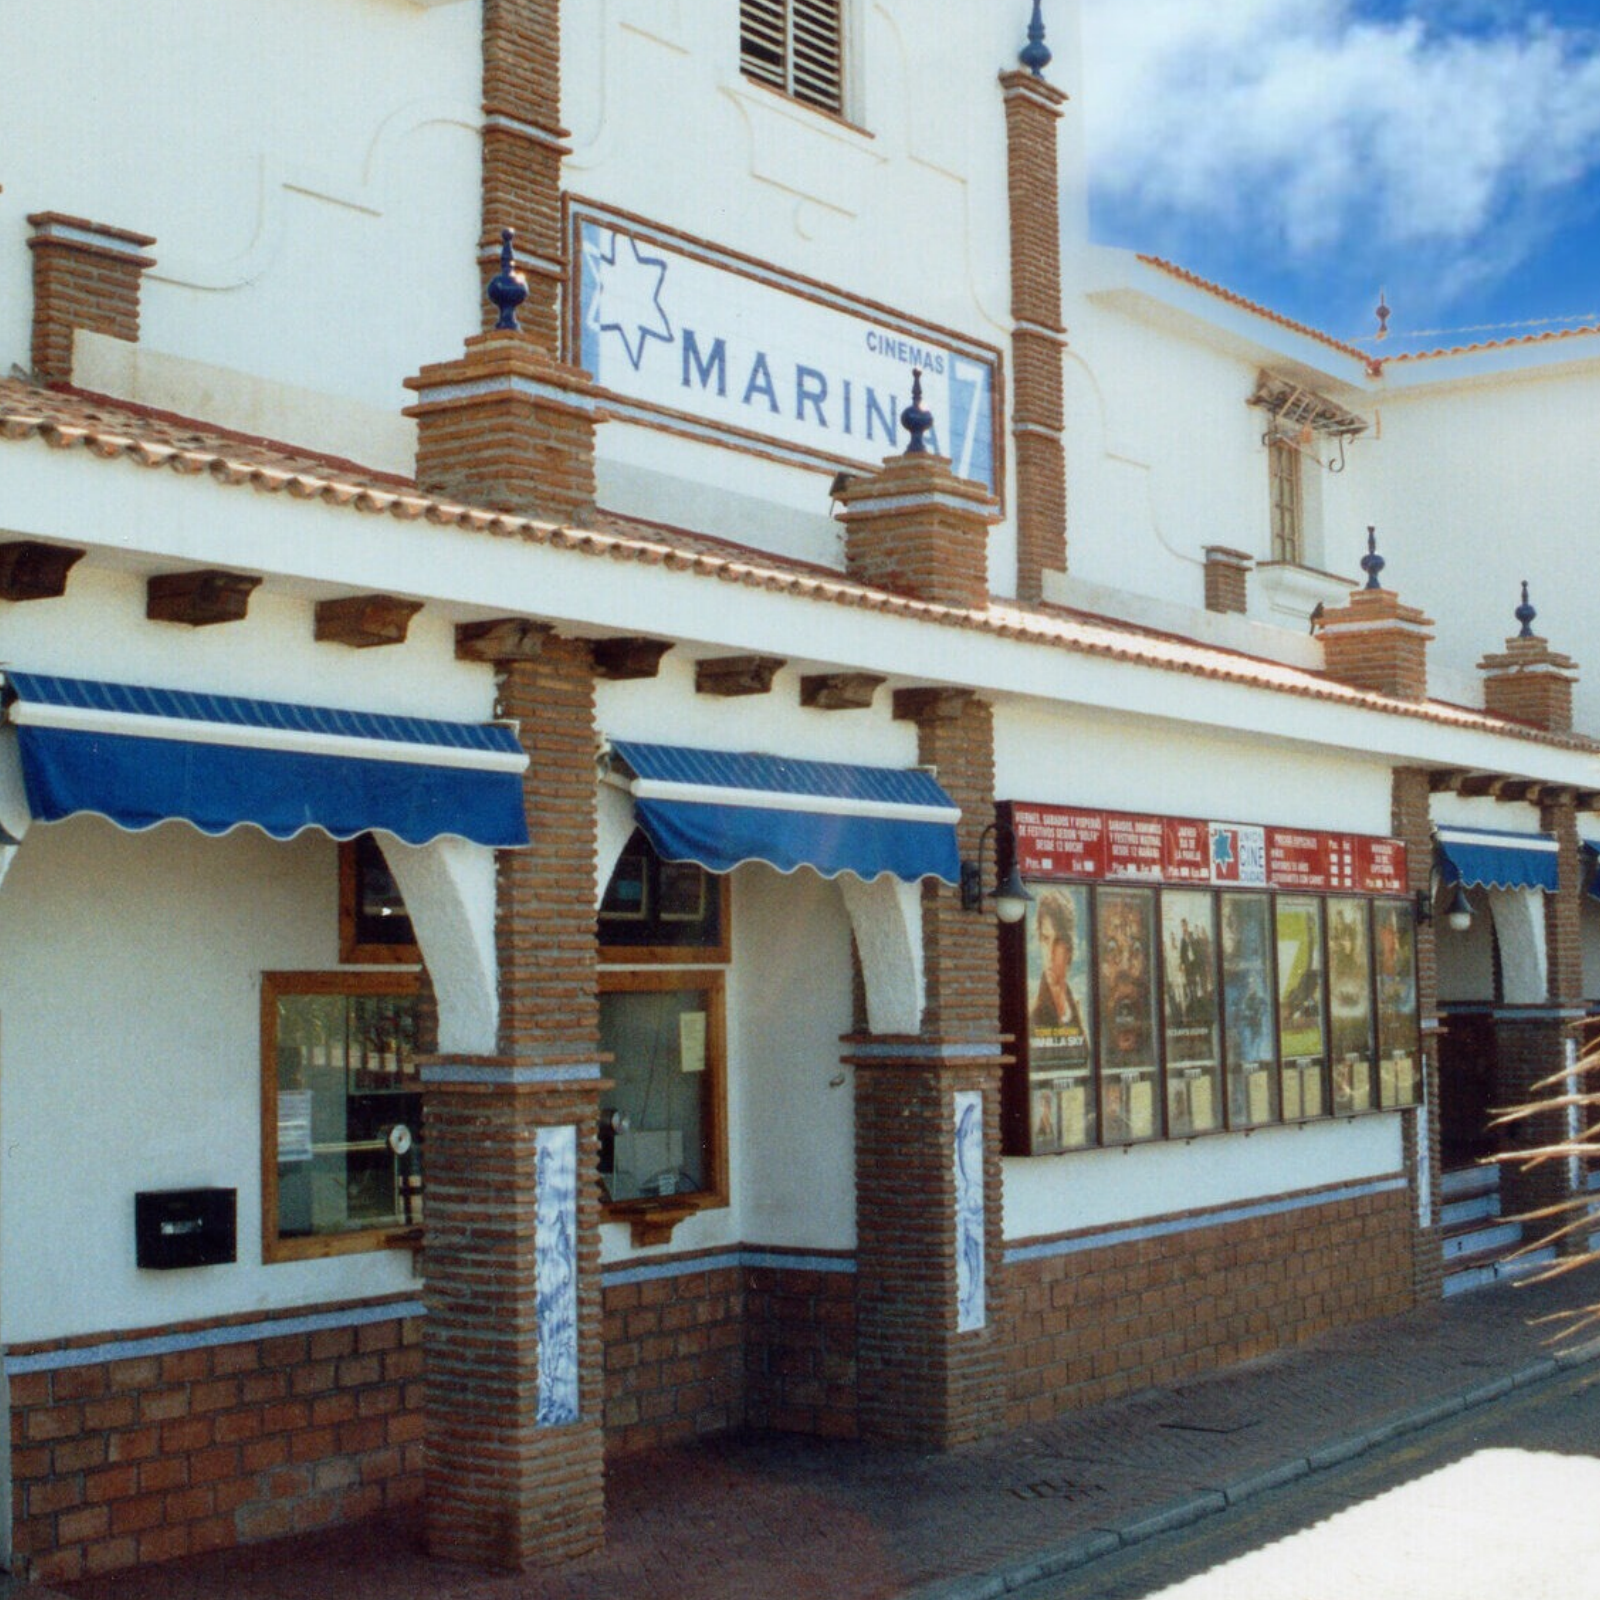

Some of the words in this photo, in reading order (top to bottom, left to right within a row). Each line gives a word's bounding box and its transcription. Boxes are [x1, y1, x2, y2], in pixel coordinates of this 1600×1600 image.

[866, 330, 944, 375] CINEMAS
[954, 361, 984, 479] 7
[1240, 844, 1265, 869] CINE
